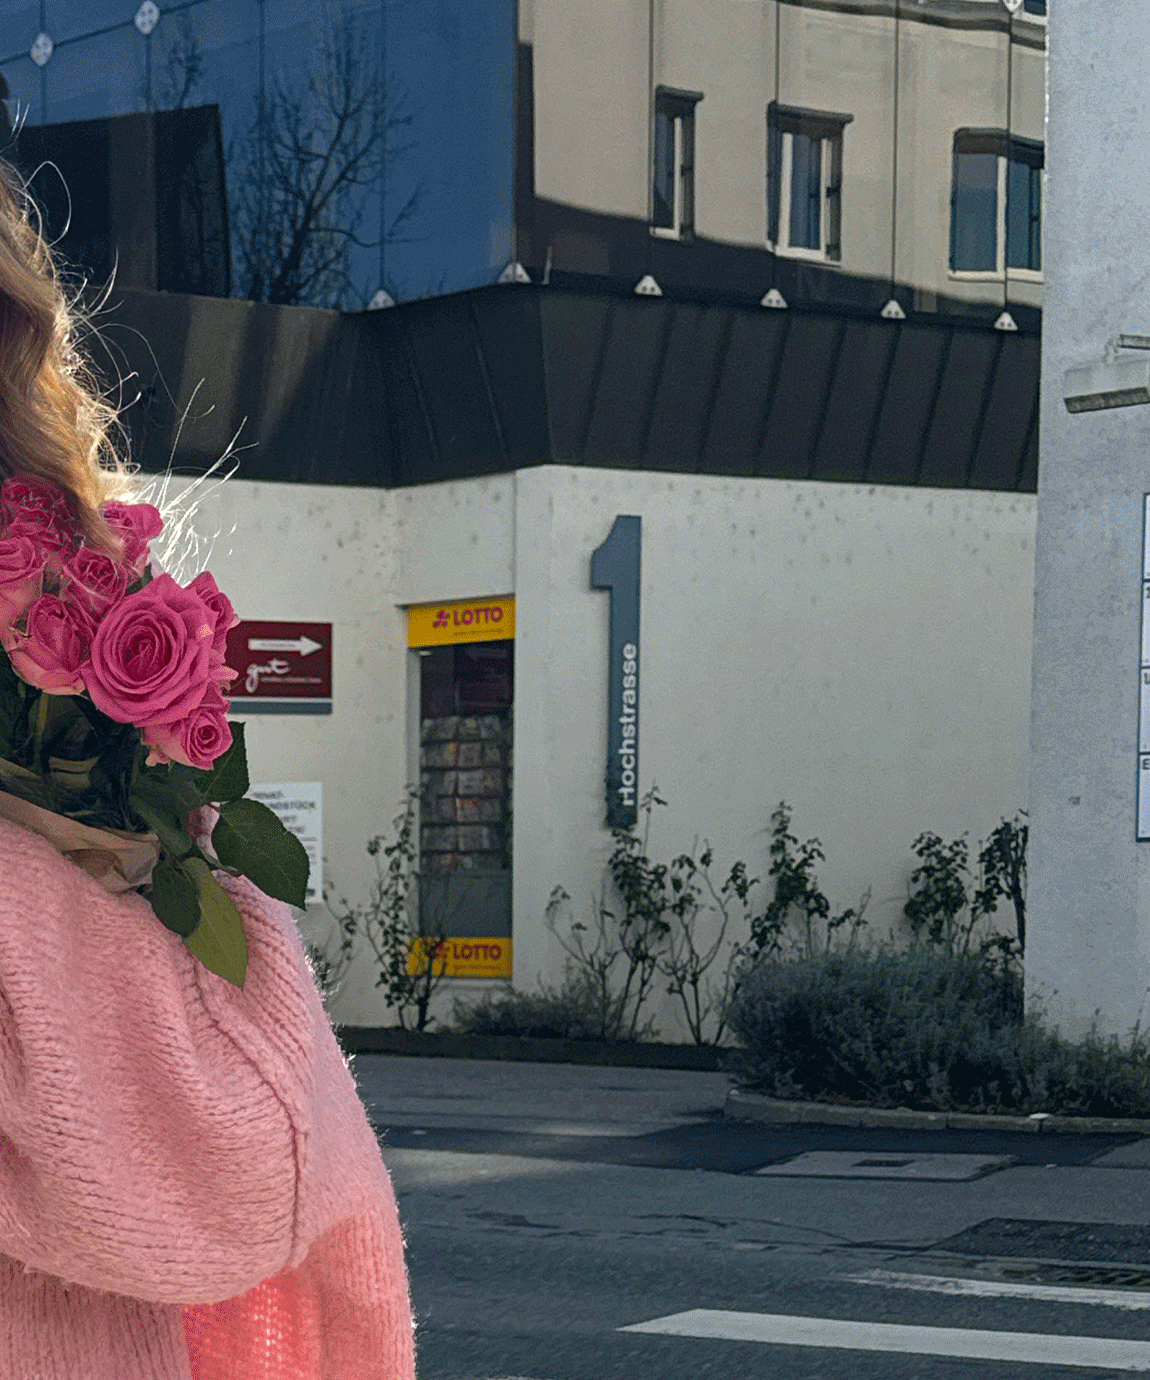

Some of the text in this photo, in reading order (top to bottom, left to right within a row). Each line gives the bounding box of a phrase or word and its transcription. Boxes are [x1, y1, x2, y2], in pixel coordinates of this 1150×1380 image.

[454, 607, 503, 627] LOTTO
[591, 515, 641, 828] 1
[618, 642, 637, 807] Hochstrasse
[453, 943, 502, 961] LOTTO
